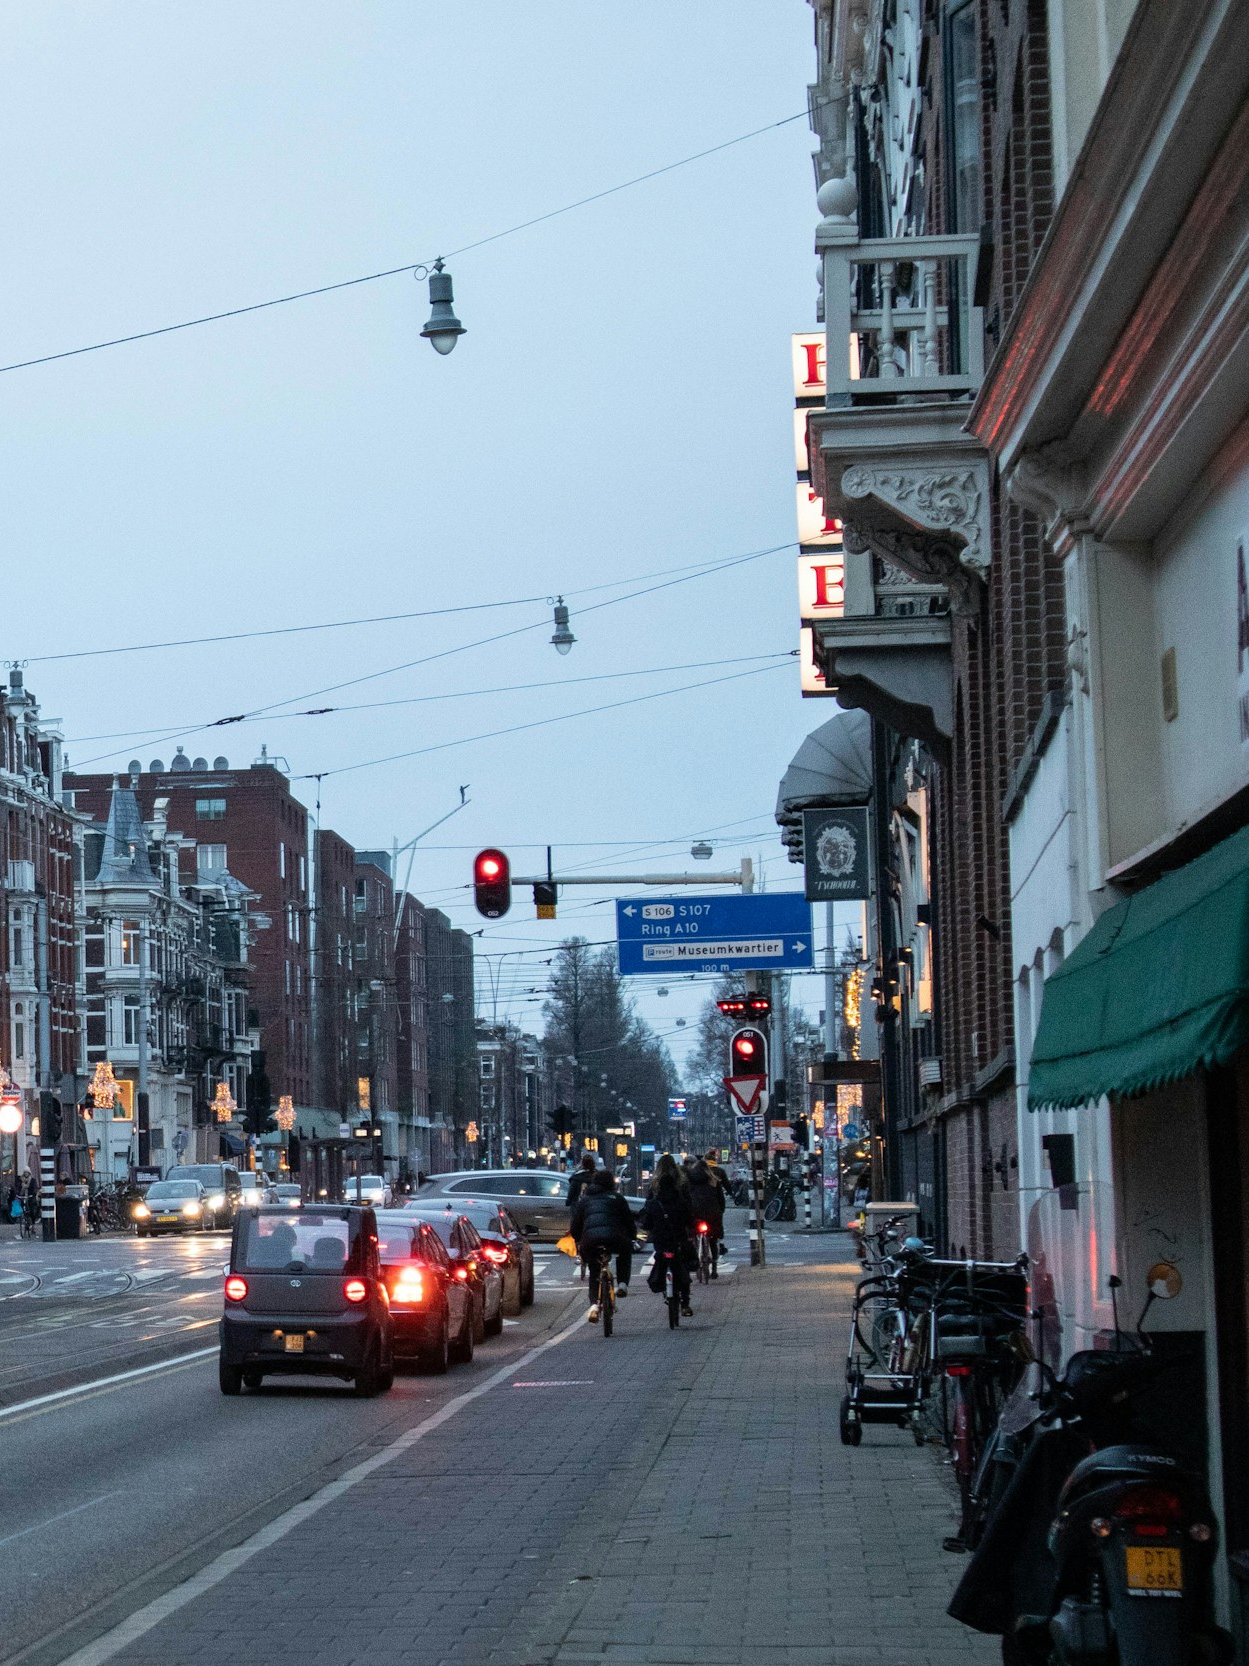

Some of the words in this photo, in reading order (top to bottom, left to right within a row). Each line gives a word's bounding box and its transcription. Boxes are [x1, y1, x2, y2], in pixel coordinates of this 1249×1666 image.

[645, 908, 651, 917] S
[655, 907, 672, 916] 106
[642, 924, 671, 937] Ring
[674, 922, 699, 934] A10
[678, 943, 779, 956] Museumkwartier
[701, 964, 717, 972] 100
[1127, 1455, 1176, 1465] KYMCO
[1144, 1550, 1176, 1567] DTL
[1146, 1573, 1178, 1586] 66K
